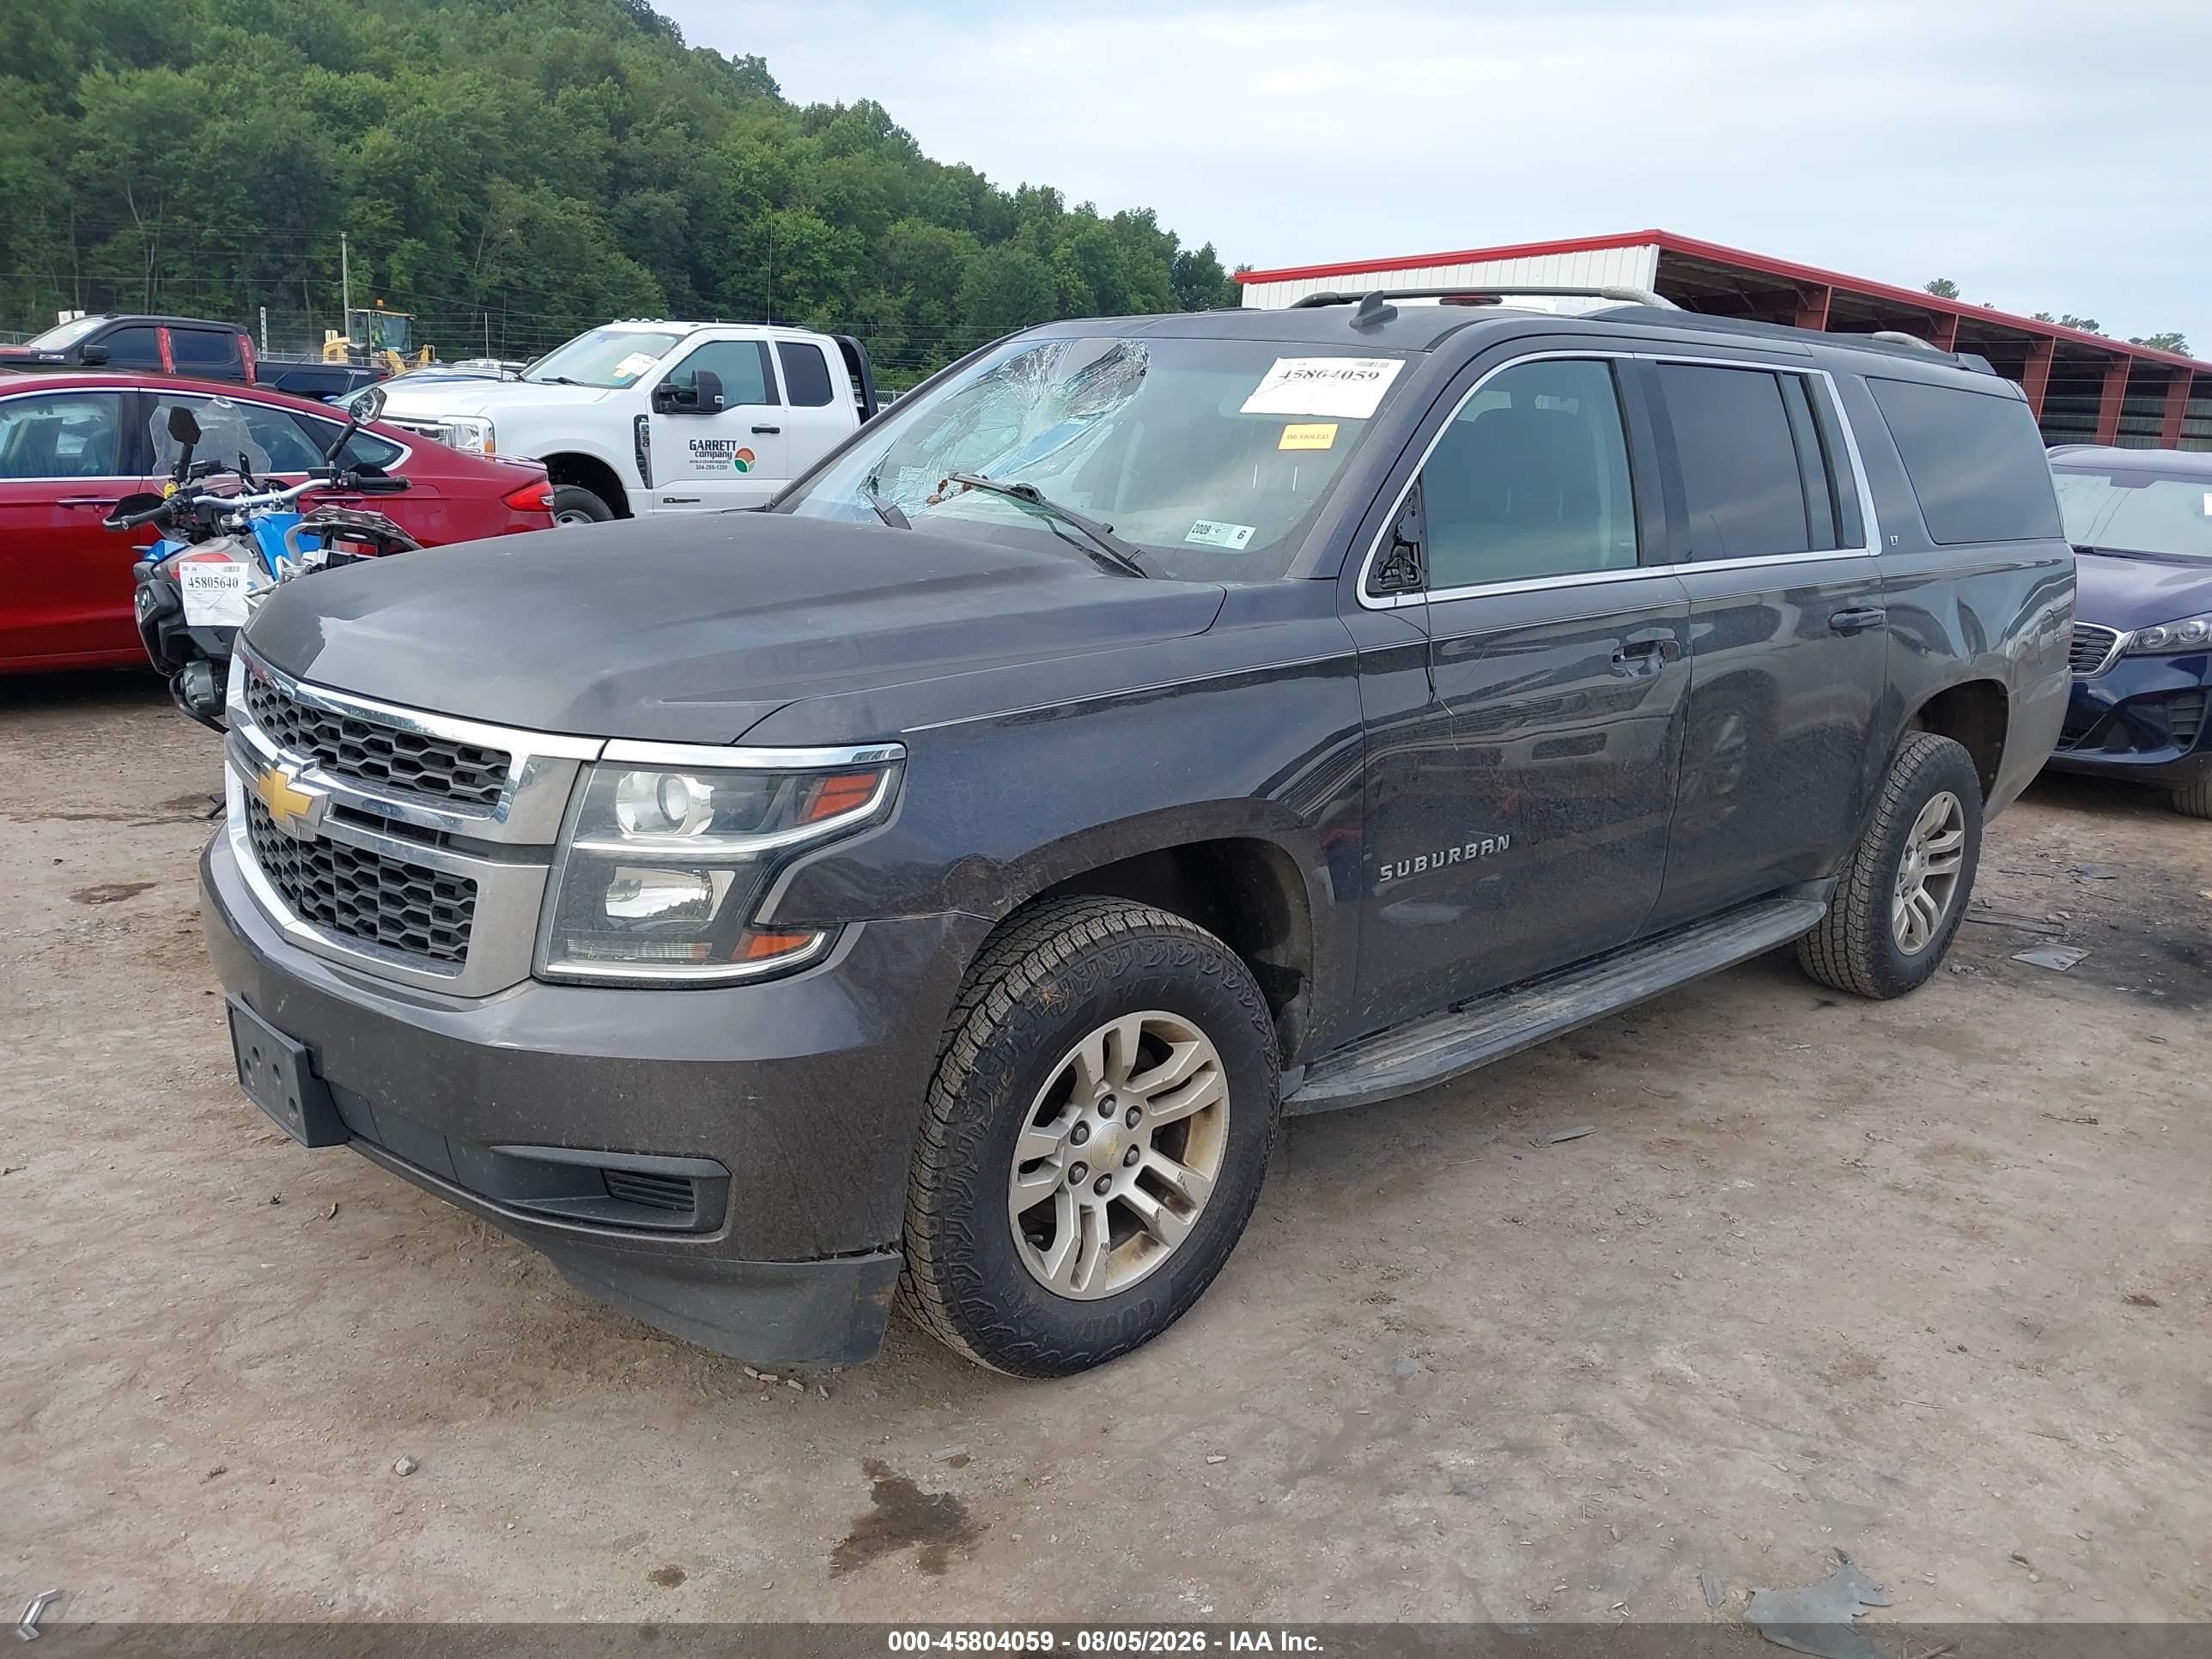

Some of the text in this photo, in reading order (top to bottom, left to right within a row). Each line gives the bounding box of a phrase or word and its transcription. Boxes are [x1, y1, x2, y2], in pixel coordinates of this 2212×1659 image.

[246, 362, 255, 379] HOLD
[689, 439, 738, 452] GARRETT
[695, 451, 732, 460] company
[1237, 529, 1247, 540] 6
[1889, 535, 1899, 546] LT
[188, 576, 239, 589] 45805640
[1379, 834, 1510, 883] SUBURBAN
